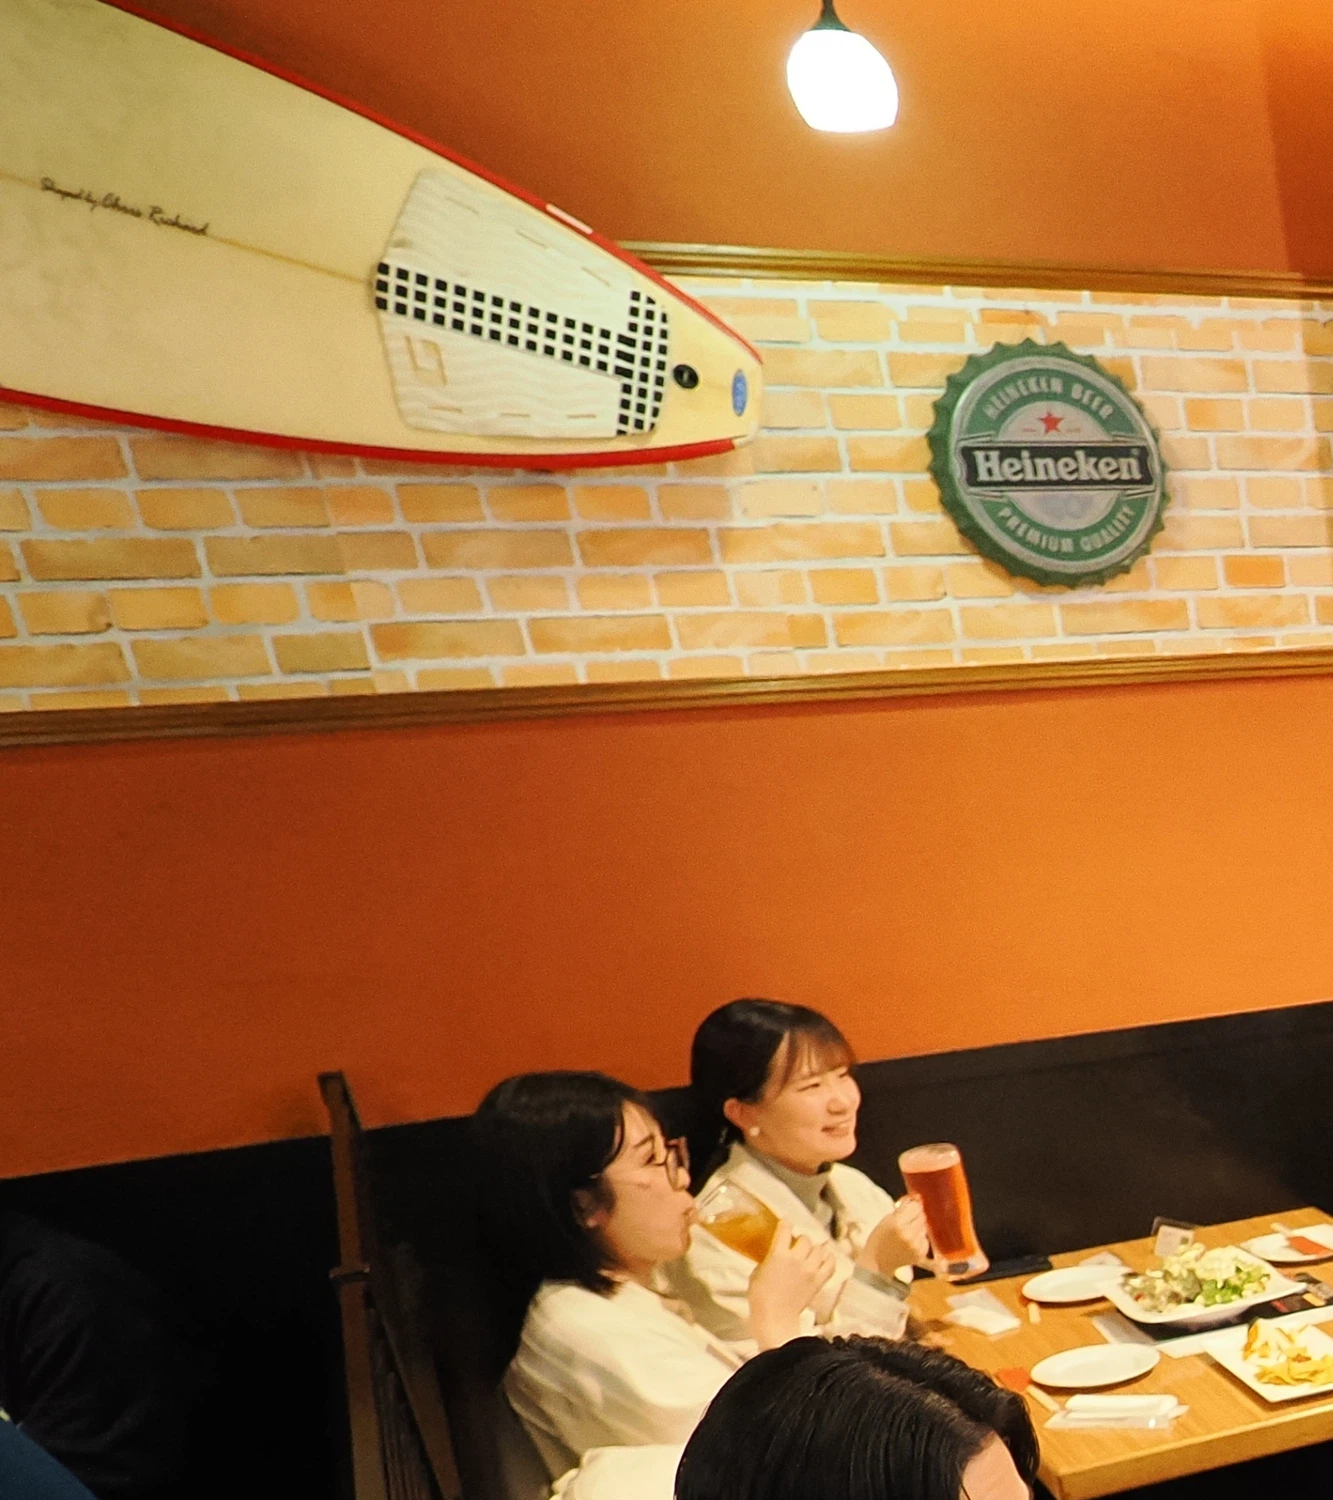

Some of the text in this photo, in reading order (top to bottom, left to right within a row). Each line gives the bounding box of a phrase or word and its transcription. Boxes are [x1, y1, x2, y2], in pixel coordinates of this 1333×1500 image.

[982, 376, 1115, 420] HEINEKEN BEER
[973, 448, 1143, 483] Heineken
[997, 504, 1136, 552] PREMIUM QUALITY
